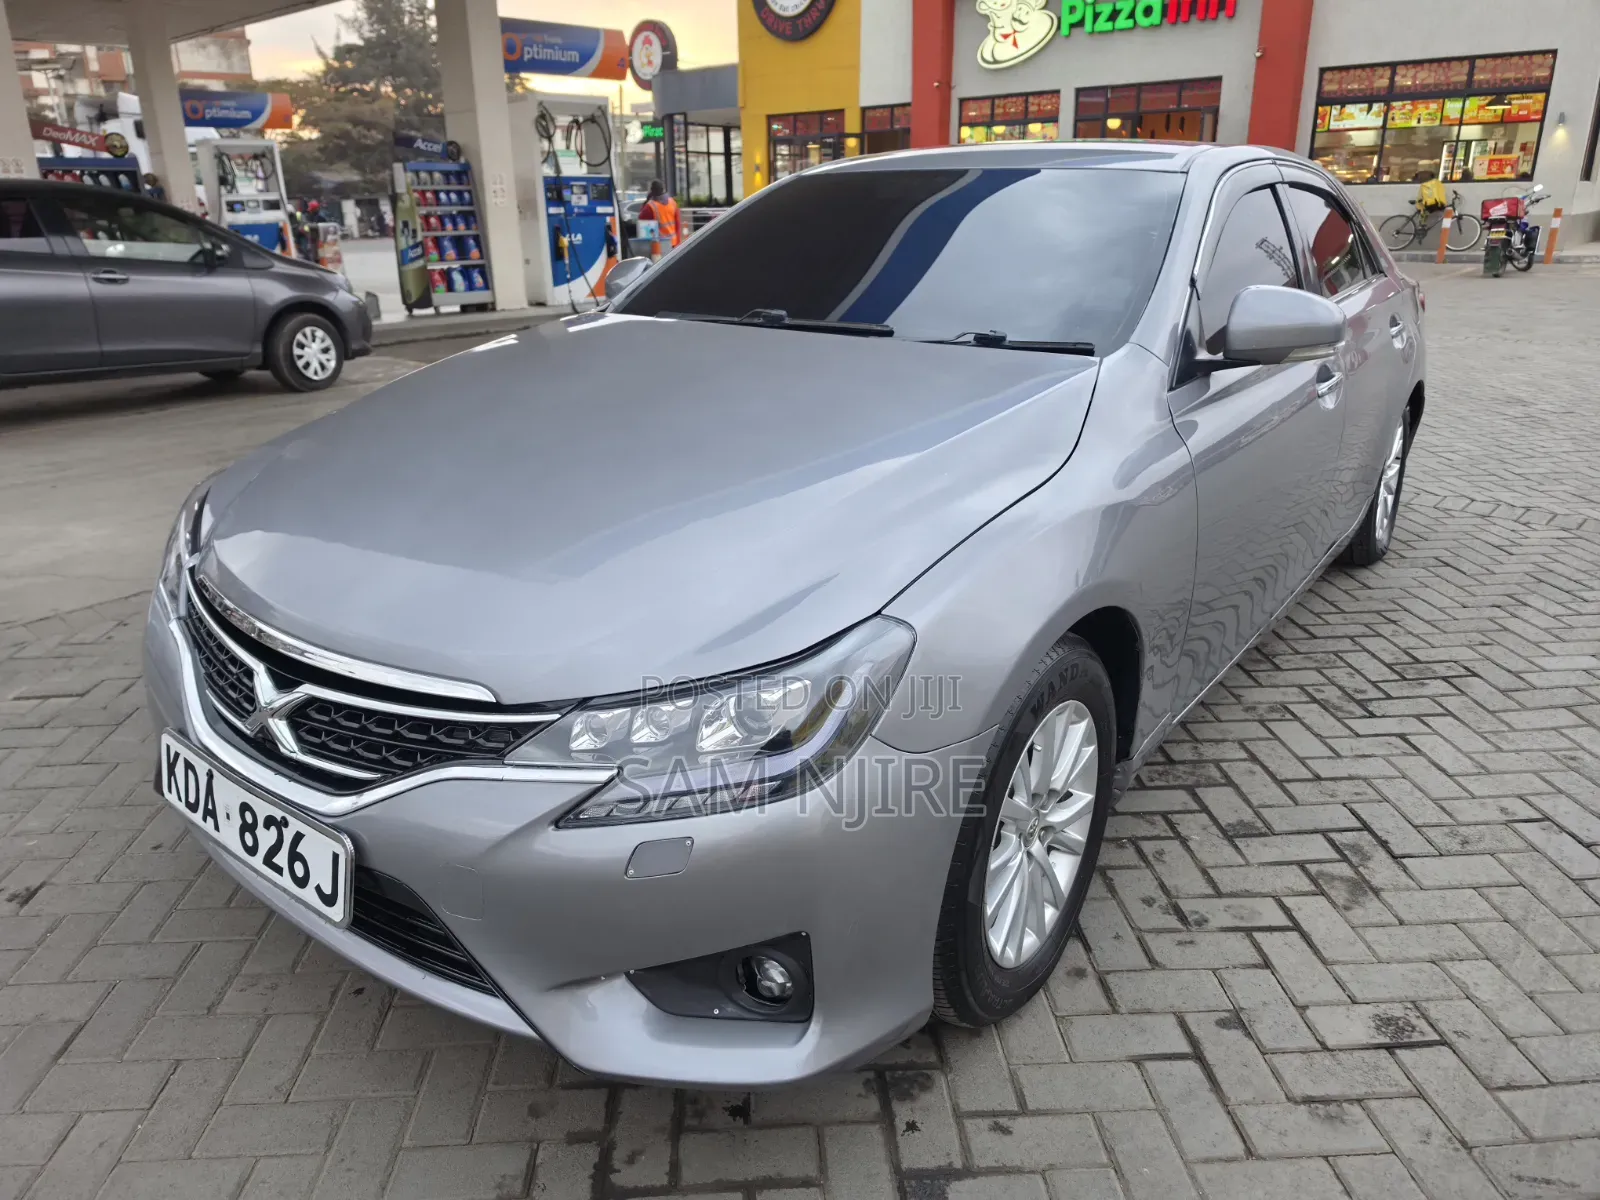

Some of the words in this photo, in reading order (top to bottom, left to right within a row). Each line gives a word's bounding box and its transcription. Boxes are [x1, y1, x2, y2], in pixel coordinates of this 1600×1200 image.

[761, 8, 793, 36] DRIVE
[1061, 0, 1163, 36] Pizza
[502, 32, 580, 63] Optimium
[413, 138, 443, 153] Accel
[165, 743, 220, 833] KDA
[239, 801, 311, 889] 826
[314, 850, 340, 908] J
